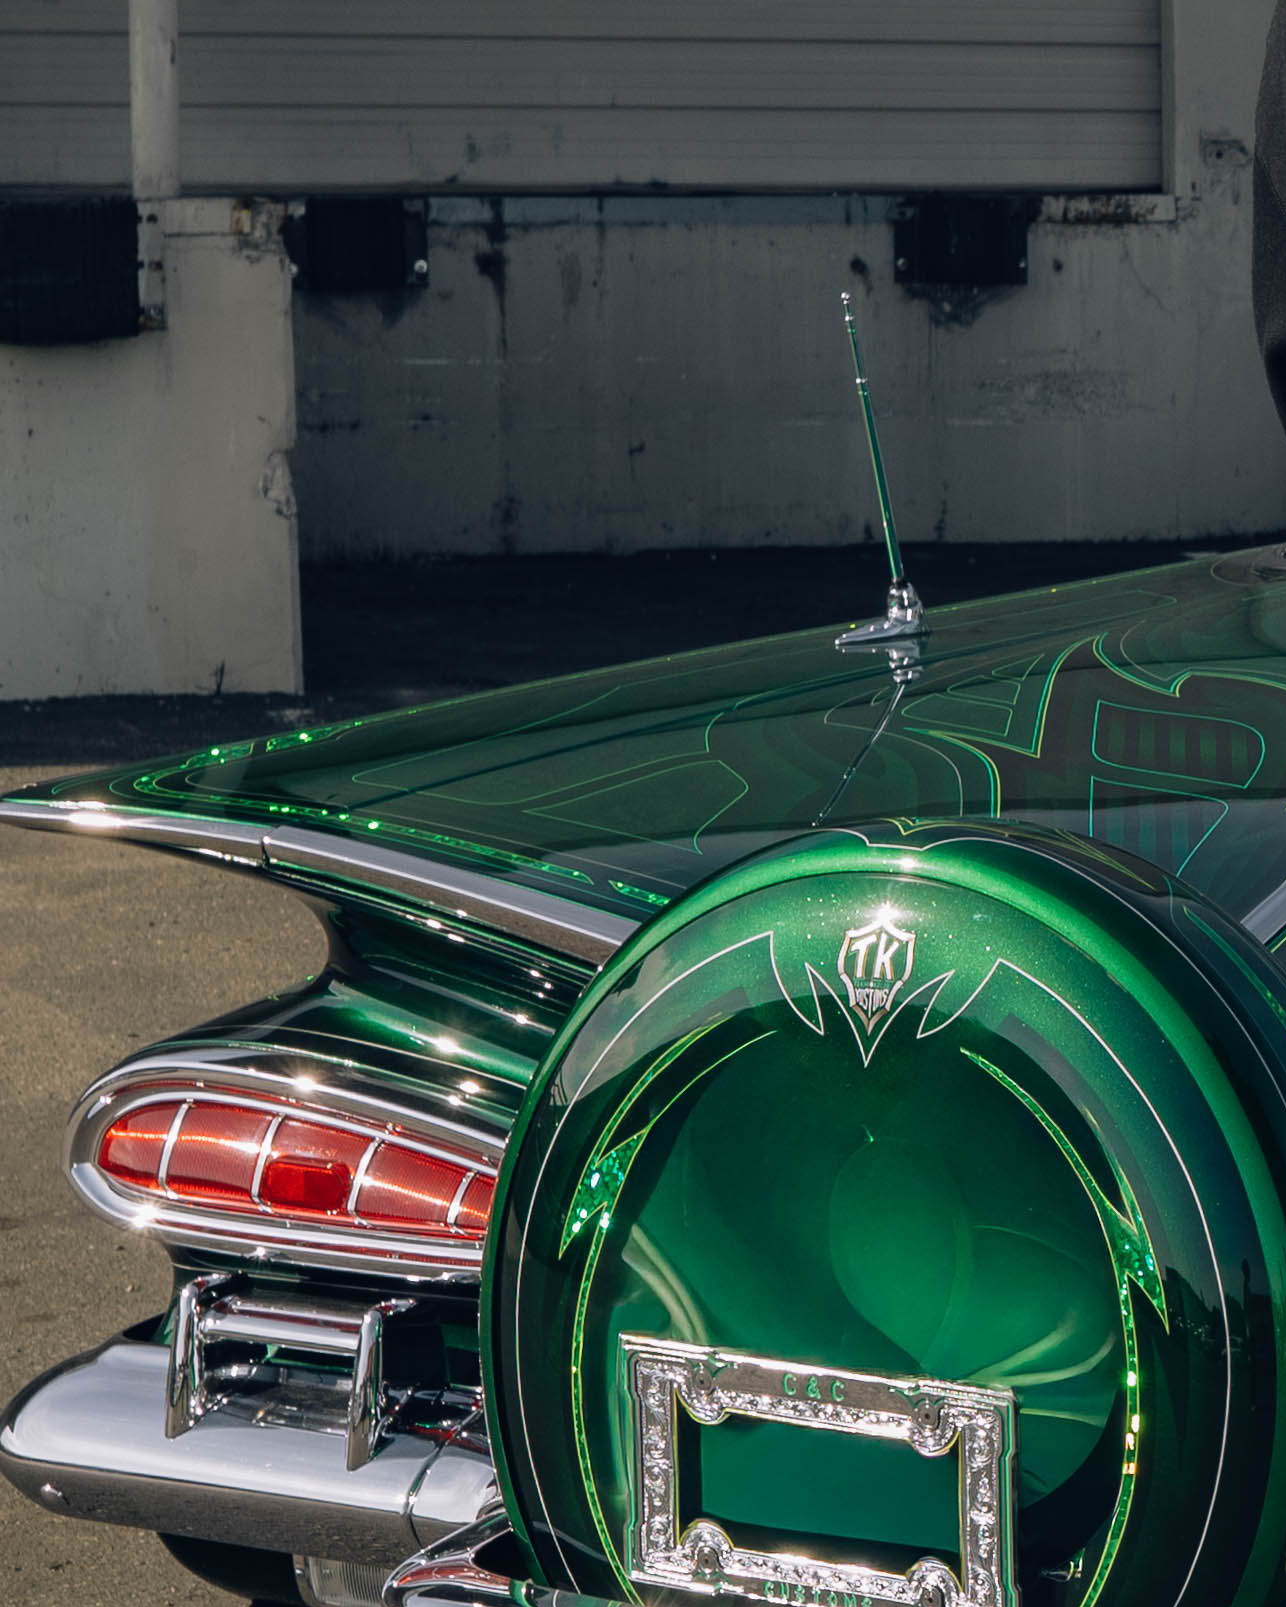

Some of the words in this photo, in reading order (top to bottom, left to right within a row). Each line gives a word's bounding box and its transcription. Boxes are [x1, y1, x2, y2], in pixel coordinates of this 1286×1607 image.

[850, 932, 900, 980] TK
[783, 1373, 797, 1395] C
[806, 1376, 821, 1399] &
[831, 1380, 845, 1402] C
